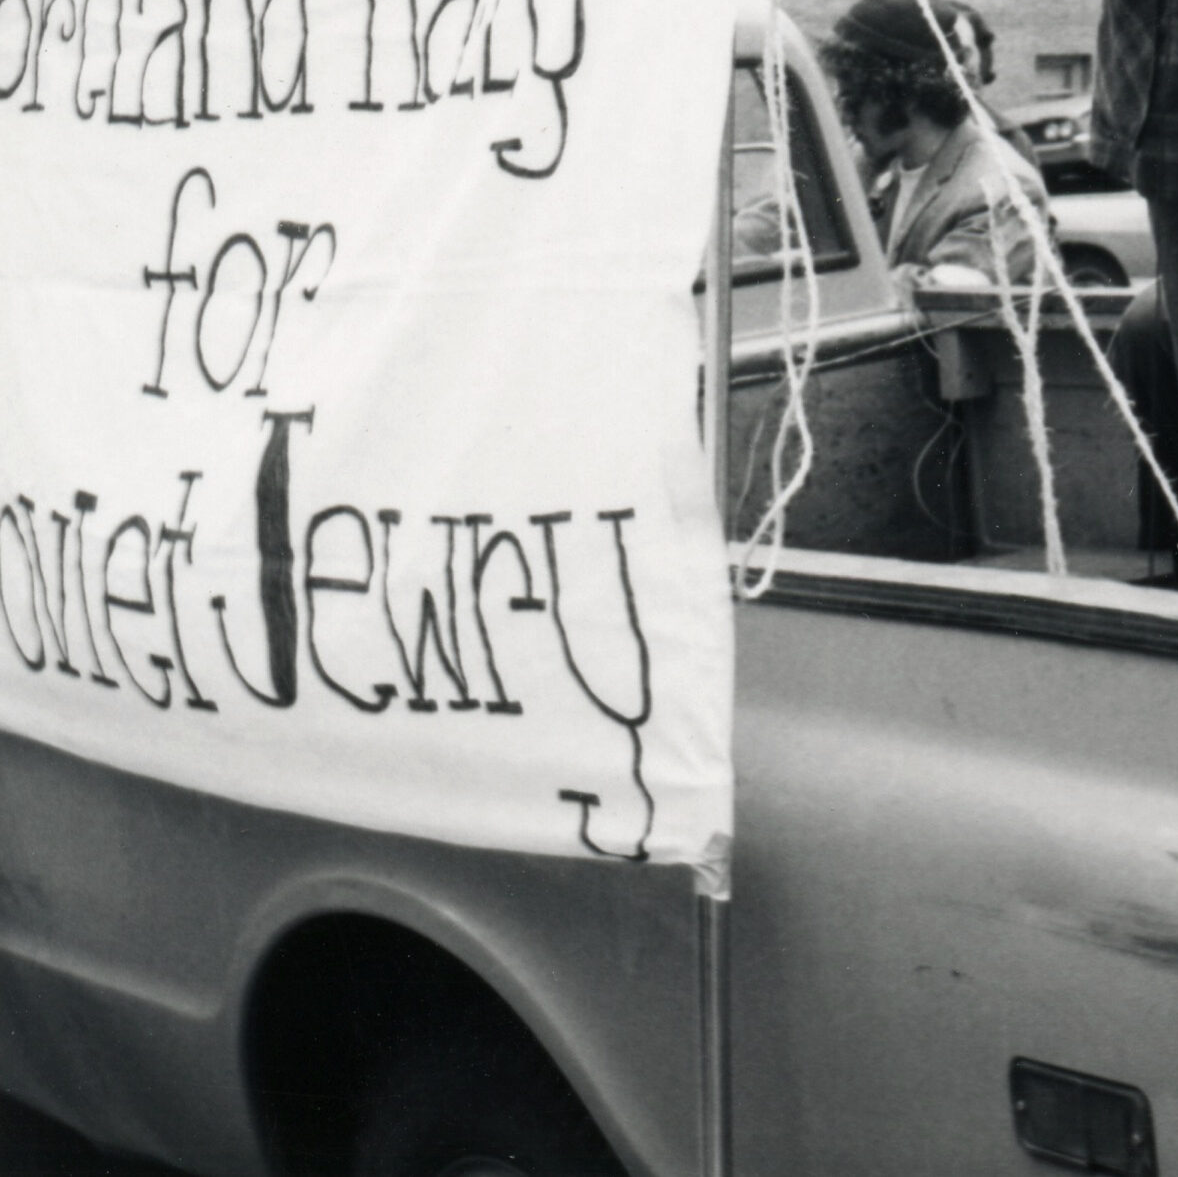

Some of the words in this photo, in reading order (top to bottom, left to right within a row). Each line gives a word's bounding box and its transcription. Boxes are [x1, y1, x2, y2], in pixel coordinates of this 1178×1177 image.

[142, 167, 337, 397] for
[0, 470, 219, 713] oviet
[209, 405, 653, 862] Jewry
